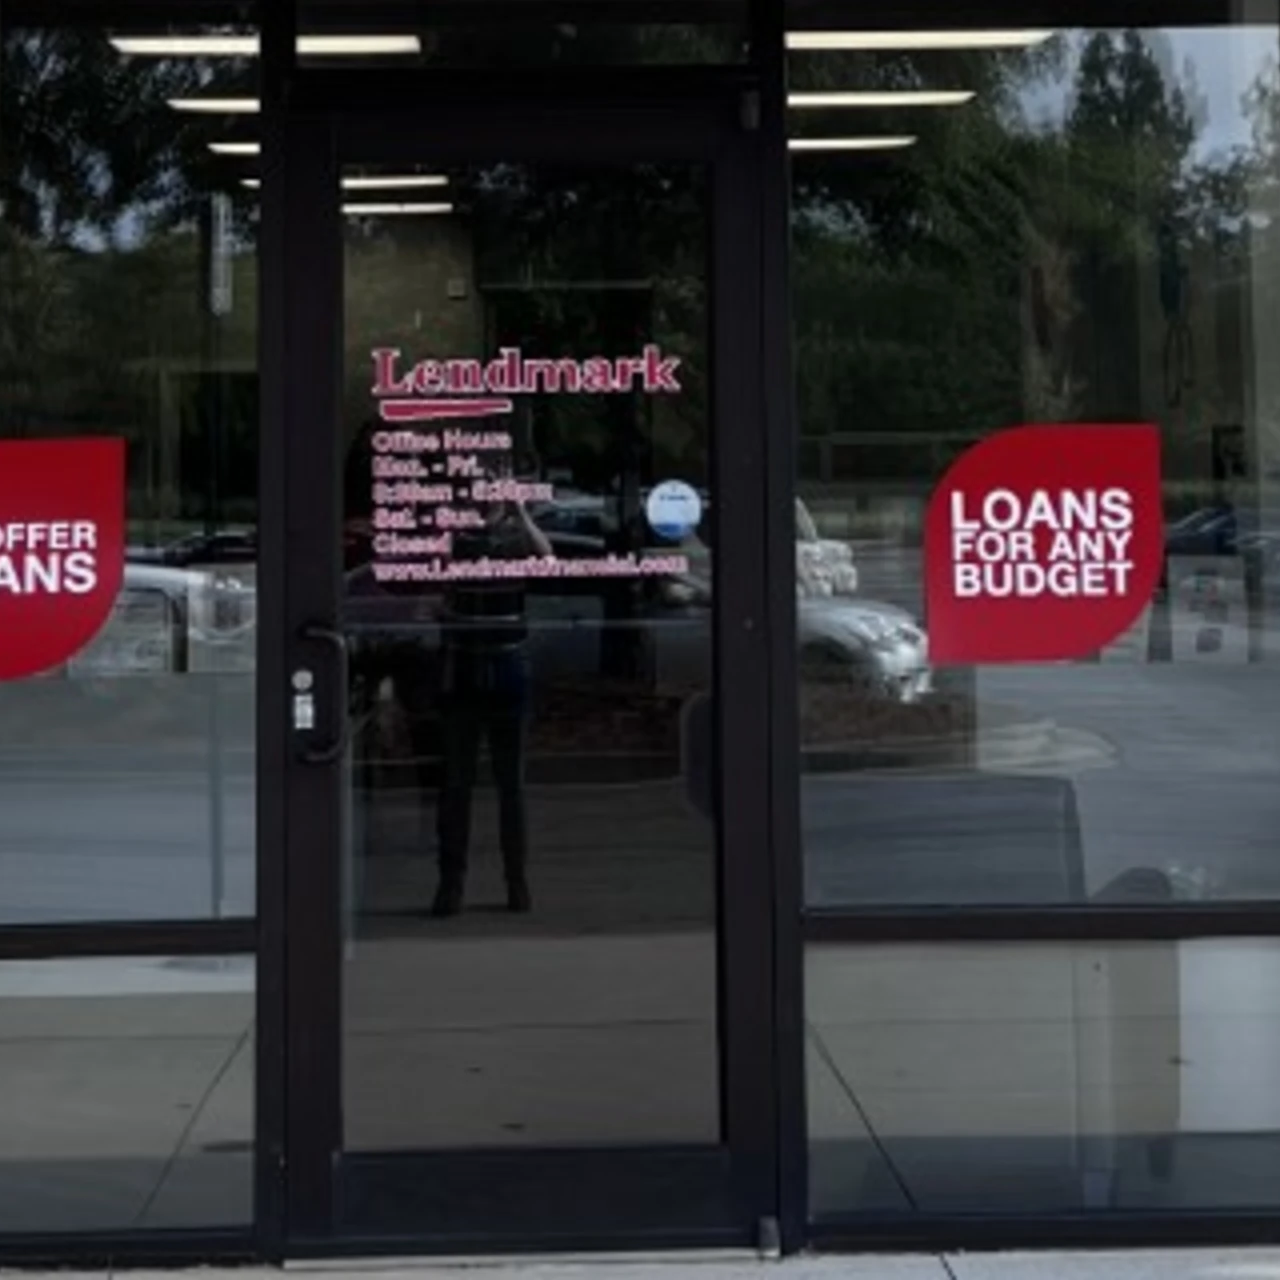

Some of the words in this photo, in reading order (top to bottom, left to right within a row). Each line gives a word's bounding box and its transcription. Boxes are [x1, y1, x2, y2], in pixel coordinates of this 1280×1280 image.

[371, 344, 681, 394] Lendmark
[372, 430, 440, 452] Office
[443, 428, 512, 450] Hours
[951, 488, 1134, 531] LOANS
[373, 531, 452, 554] Closed
[954, 531, 1036, 561] FOR
[1047, 531, 1133, 560] ANY
[955, 562, 1134, 597] BUDGET
